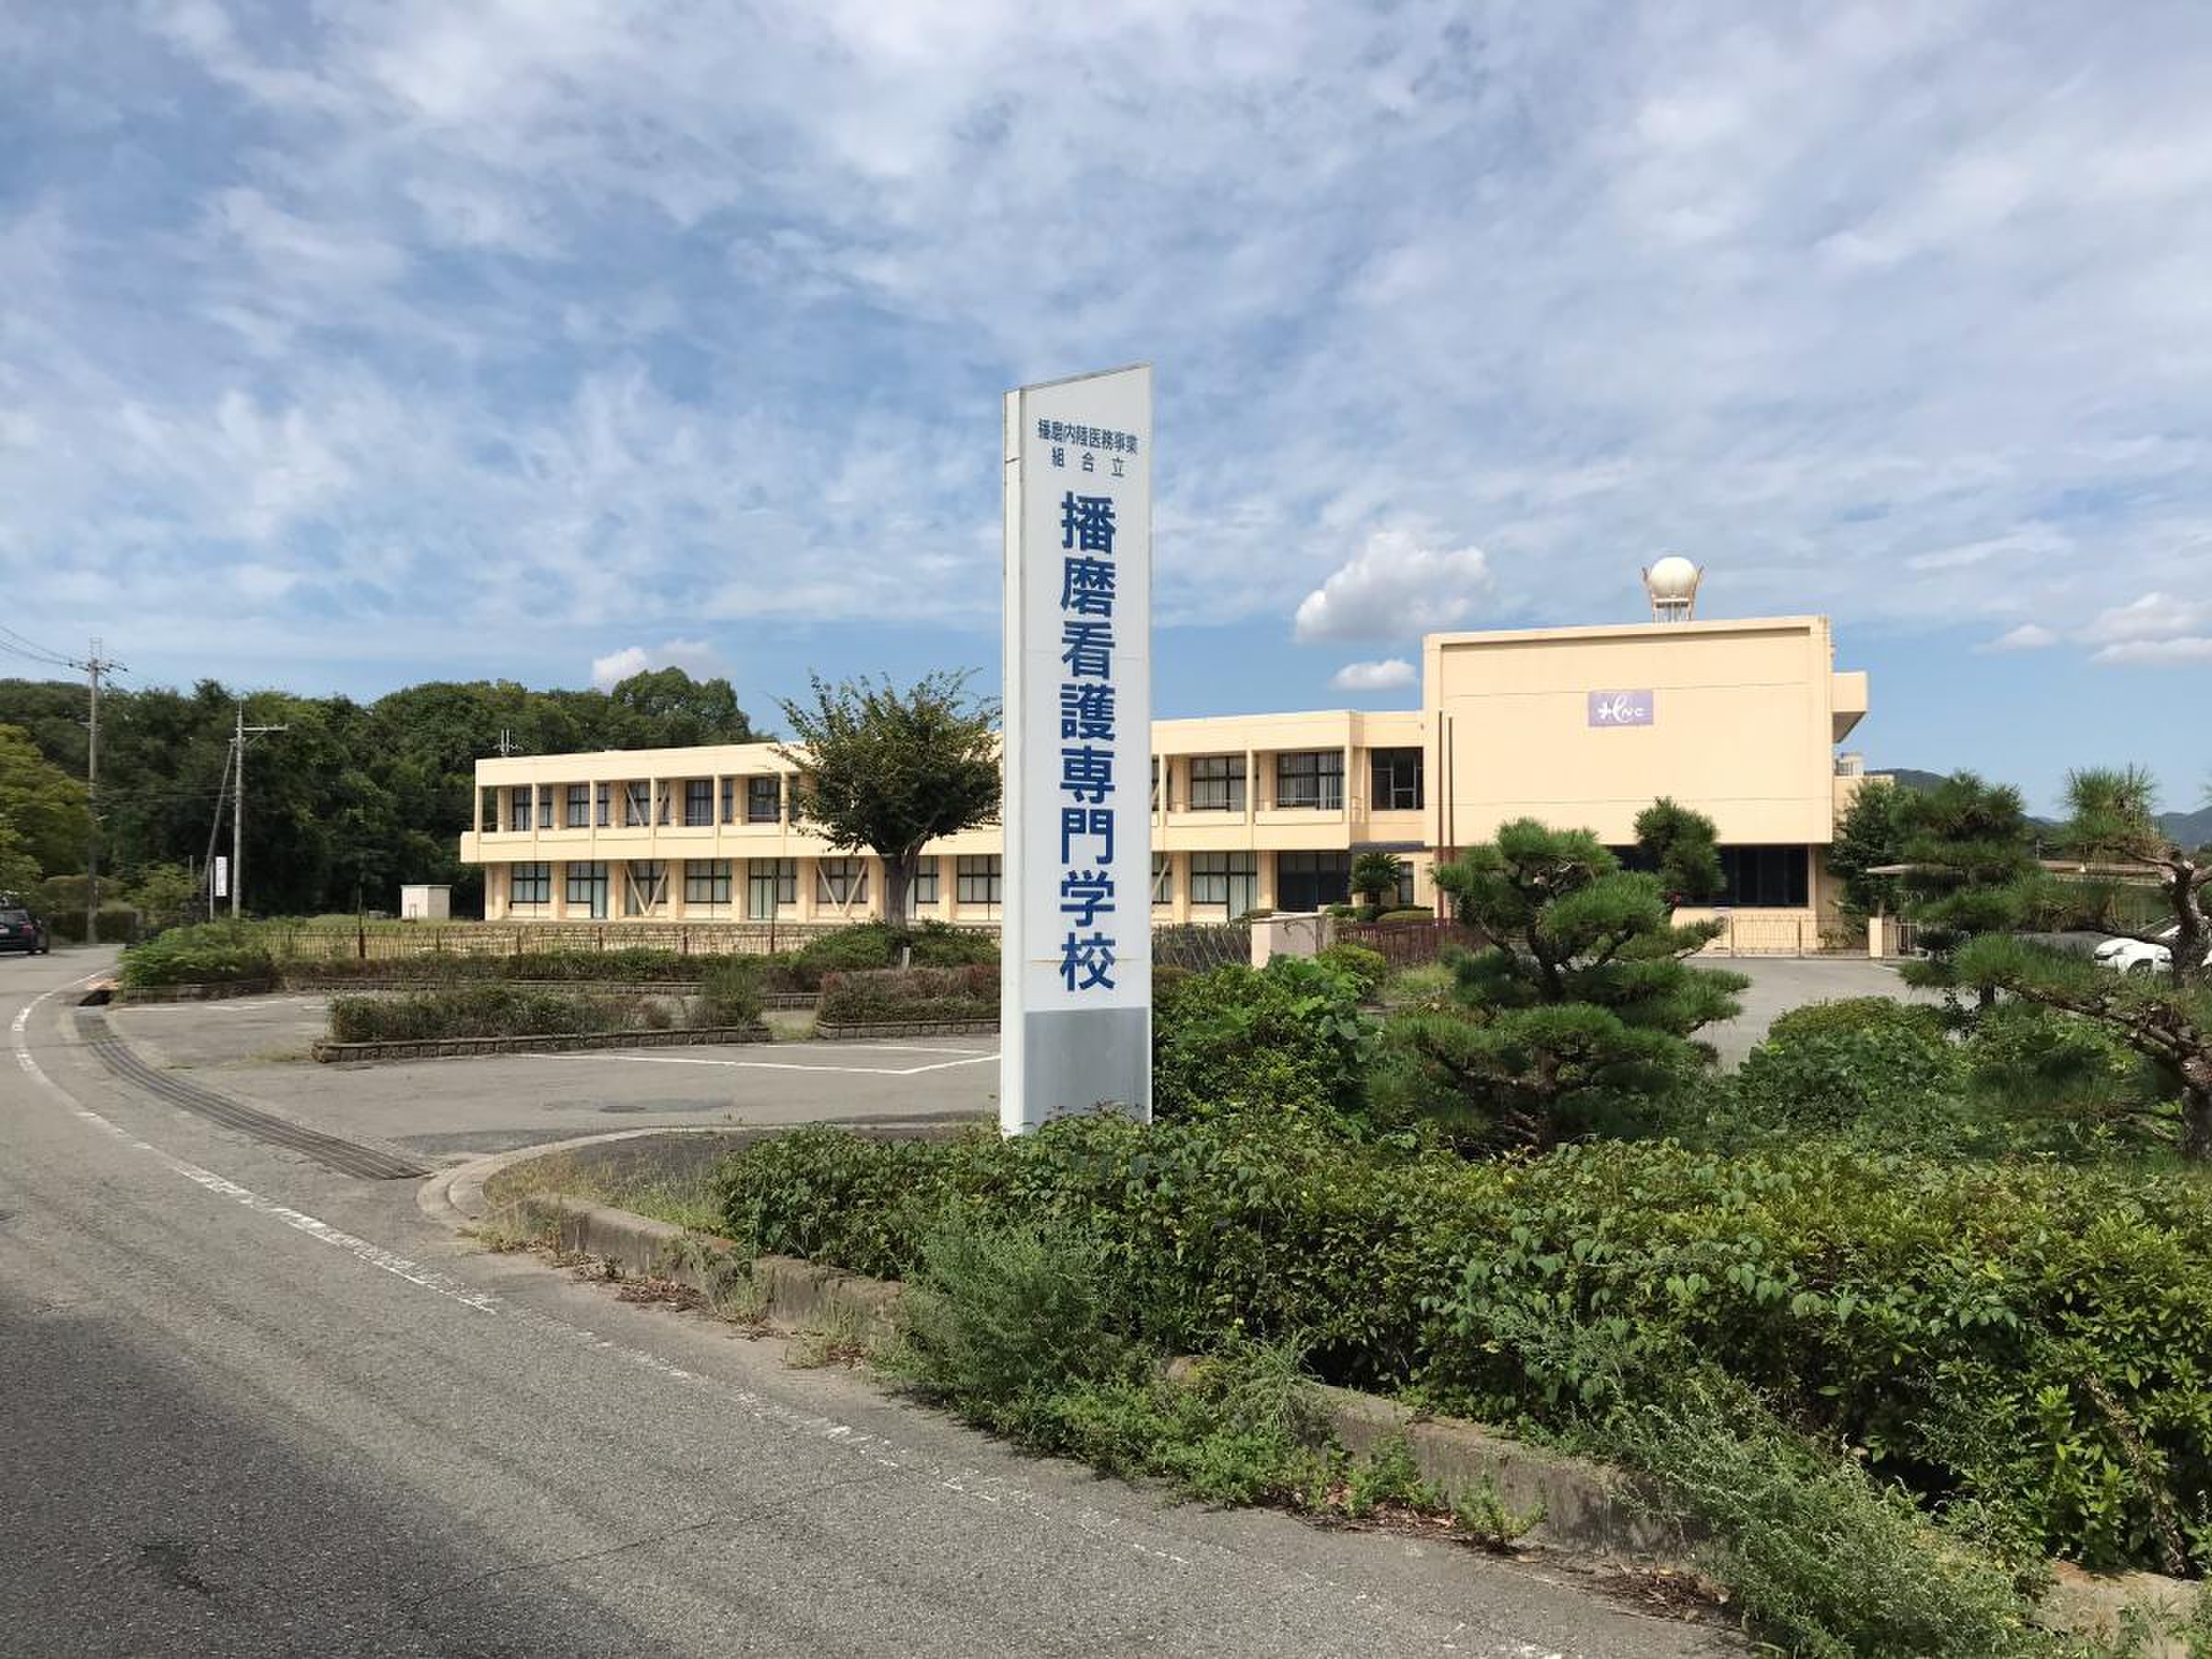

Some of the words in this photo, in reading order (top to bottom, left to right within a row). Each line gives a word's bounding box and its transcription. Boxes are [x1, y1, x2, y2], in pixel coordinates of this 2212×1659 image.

[1060, 491, 1116, 992] 播磨看護専門学校
